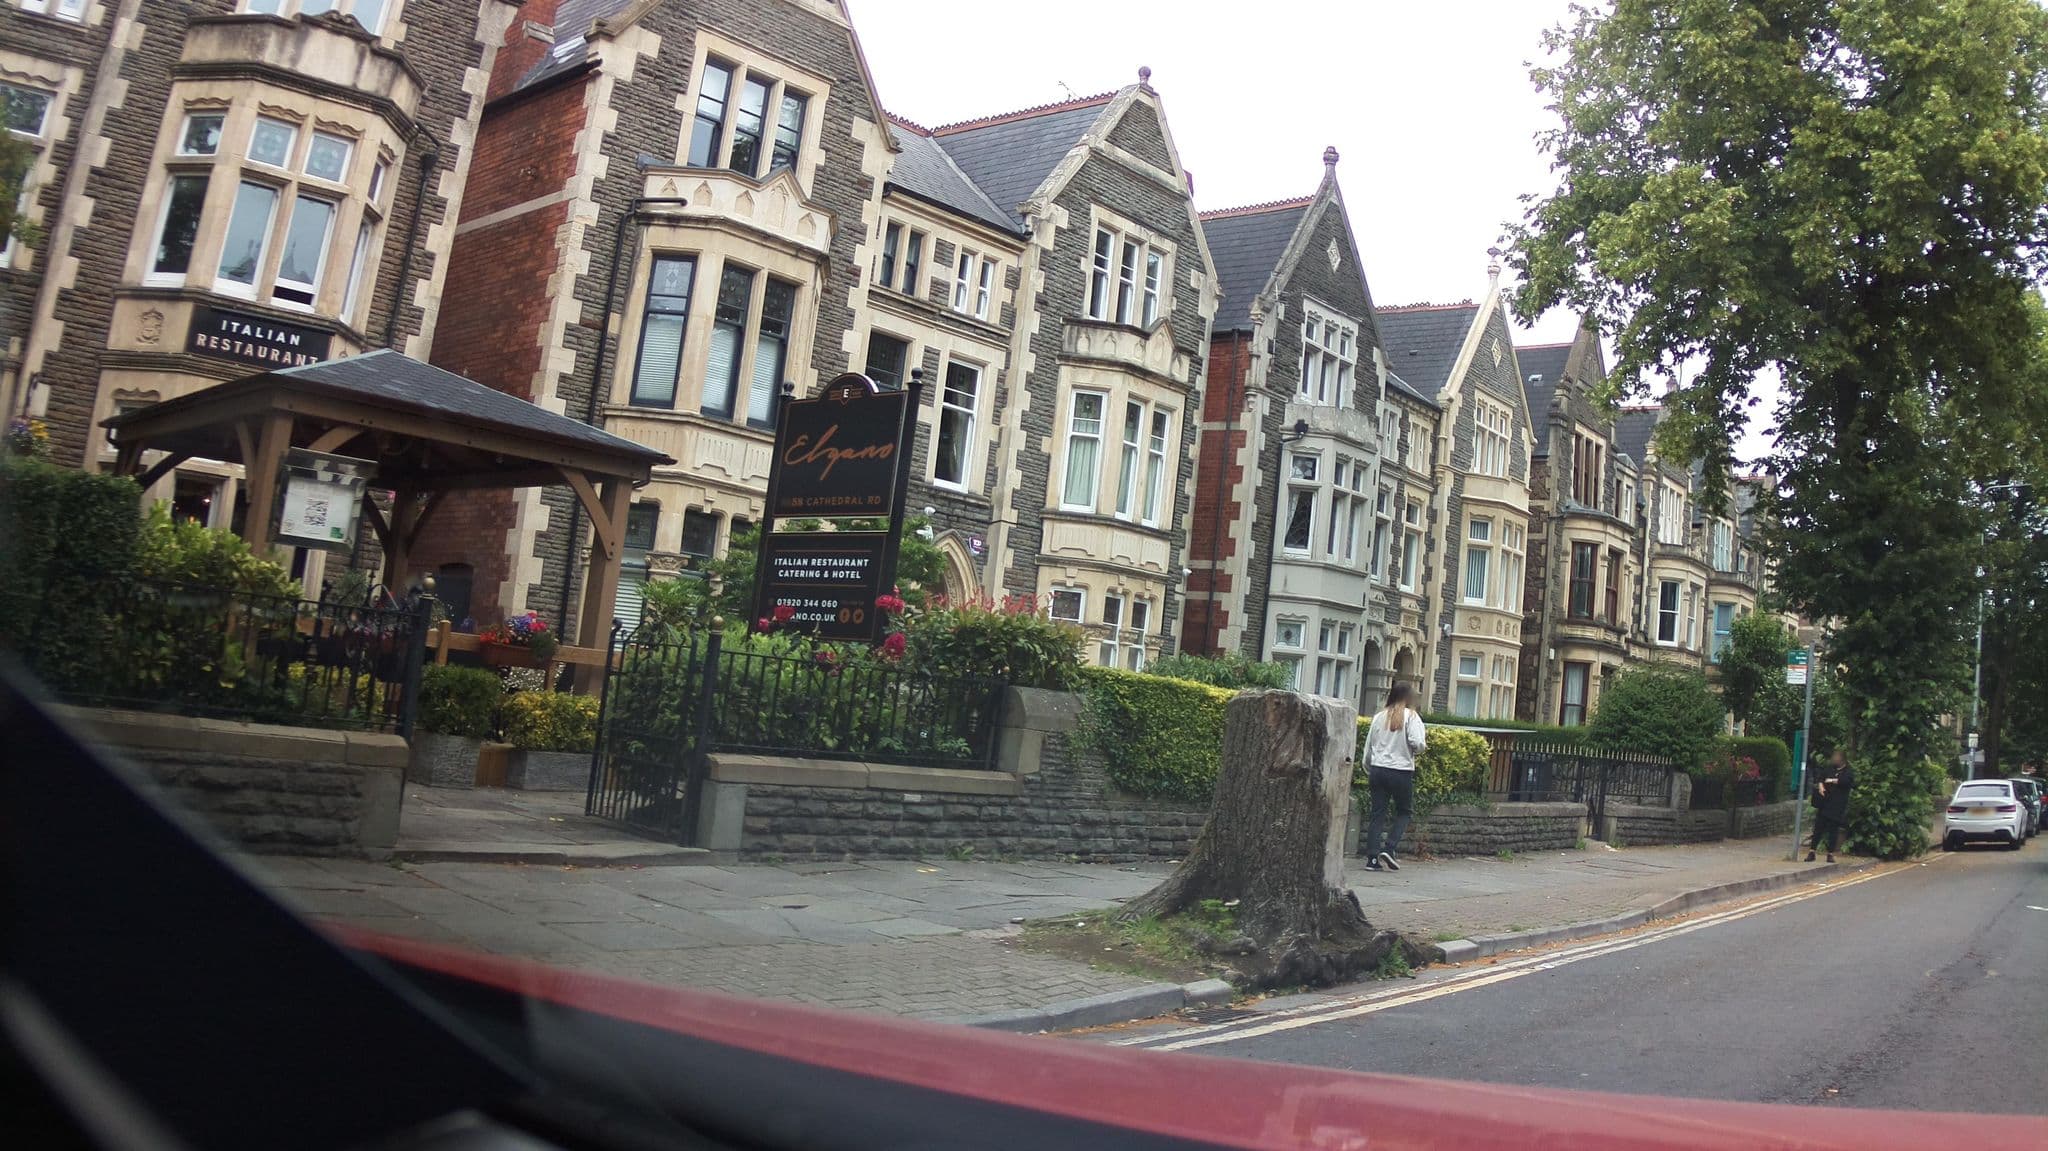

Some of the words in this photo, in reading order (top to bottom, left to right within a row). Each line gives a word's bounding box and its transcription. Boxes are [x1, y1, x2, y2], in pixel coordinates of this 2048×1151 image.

[221, 319, 301, 346] ITALIAN
[196, 333, 319, 367] RESTAURANT
[806, 496, 864, 506] CATHEDRAL
[867, 495, 881, 505] RD
[774, 558, 809, 566] ITALIAN
[811, 558, 870, 567] RESTAURANT
[778, 569, 821, 578] CATERING
[823, 570, 829, 578] &
[832, 570, 861, 579] HOTEL
[803, 599, 819, 607] 344
[821, 600, 838, 608] 060
